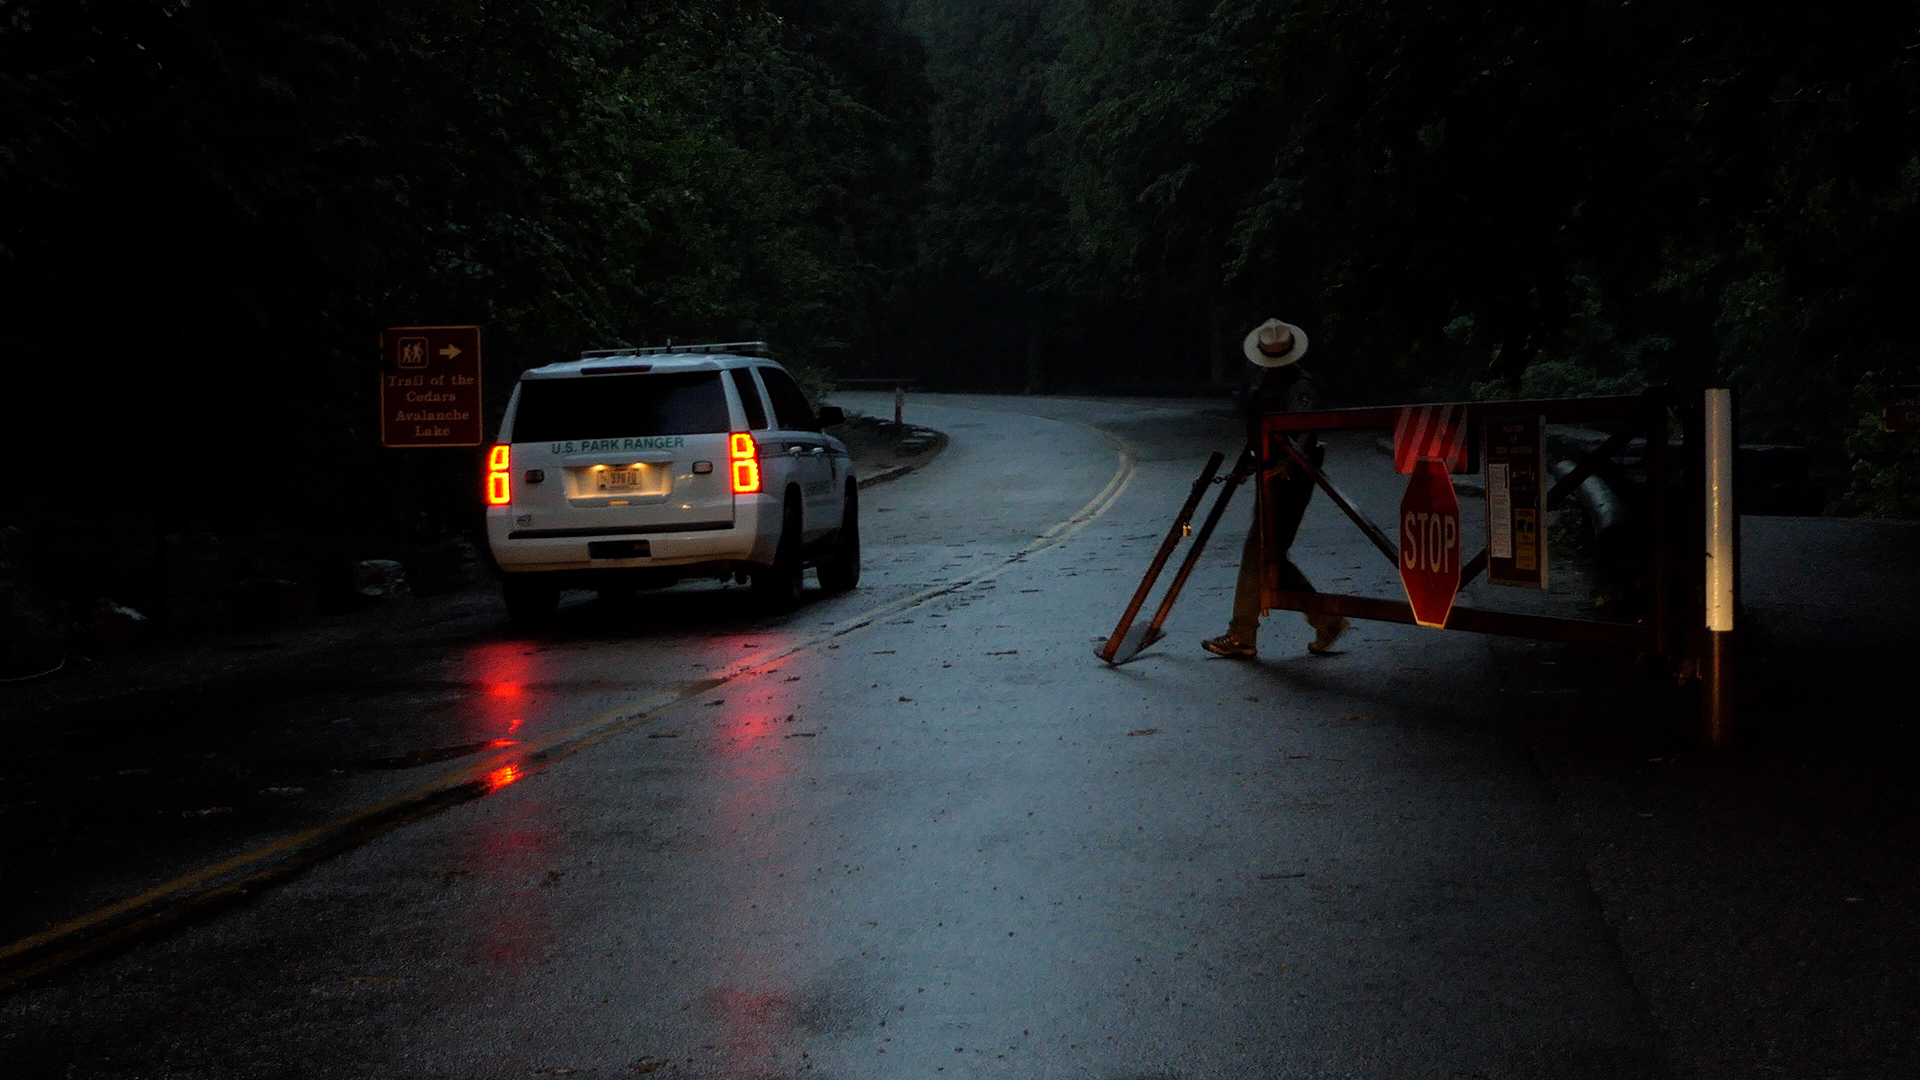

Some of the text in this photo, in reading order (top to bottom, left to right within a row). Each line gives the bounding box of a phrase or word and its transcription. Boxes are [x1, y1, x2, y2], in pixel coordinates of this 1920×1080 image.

[388, 374, 475, 387] Trail of the
[406, 390, 457, 402] Cedars
[395, 409, 470, 421] Avalanche
[415, 425, 451, 437] Lake
[552, 437, 684, 454] U.S. PARK RANGER
[1404, 511, 1456, 574] STOP
